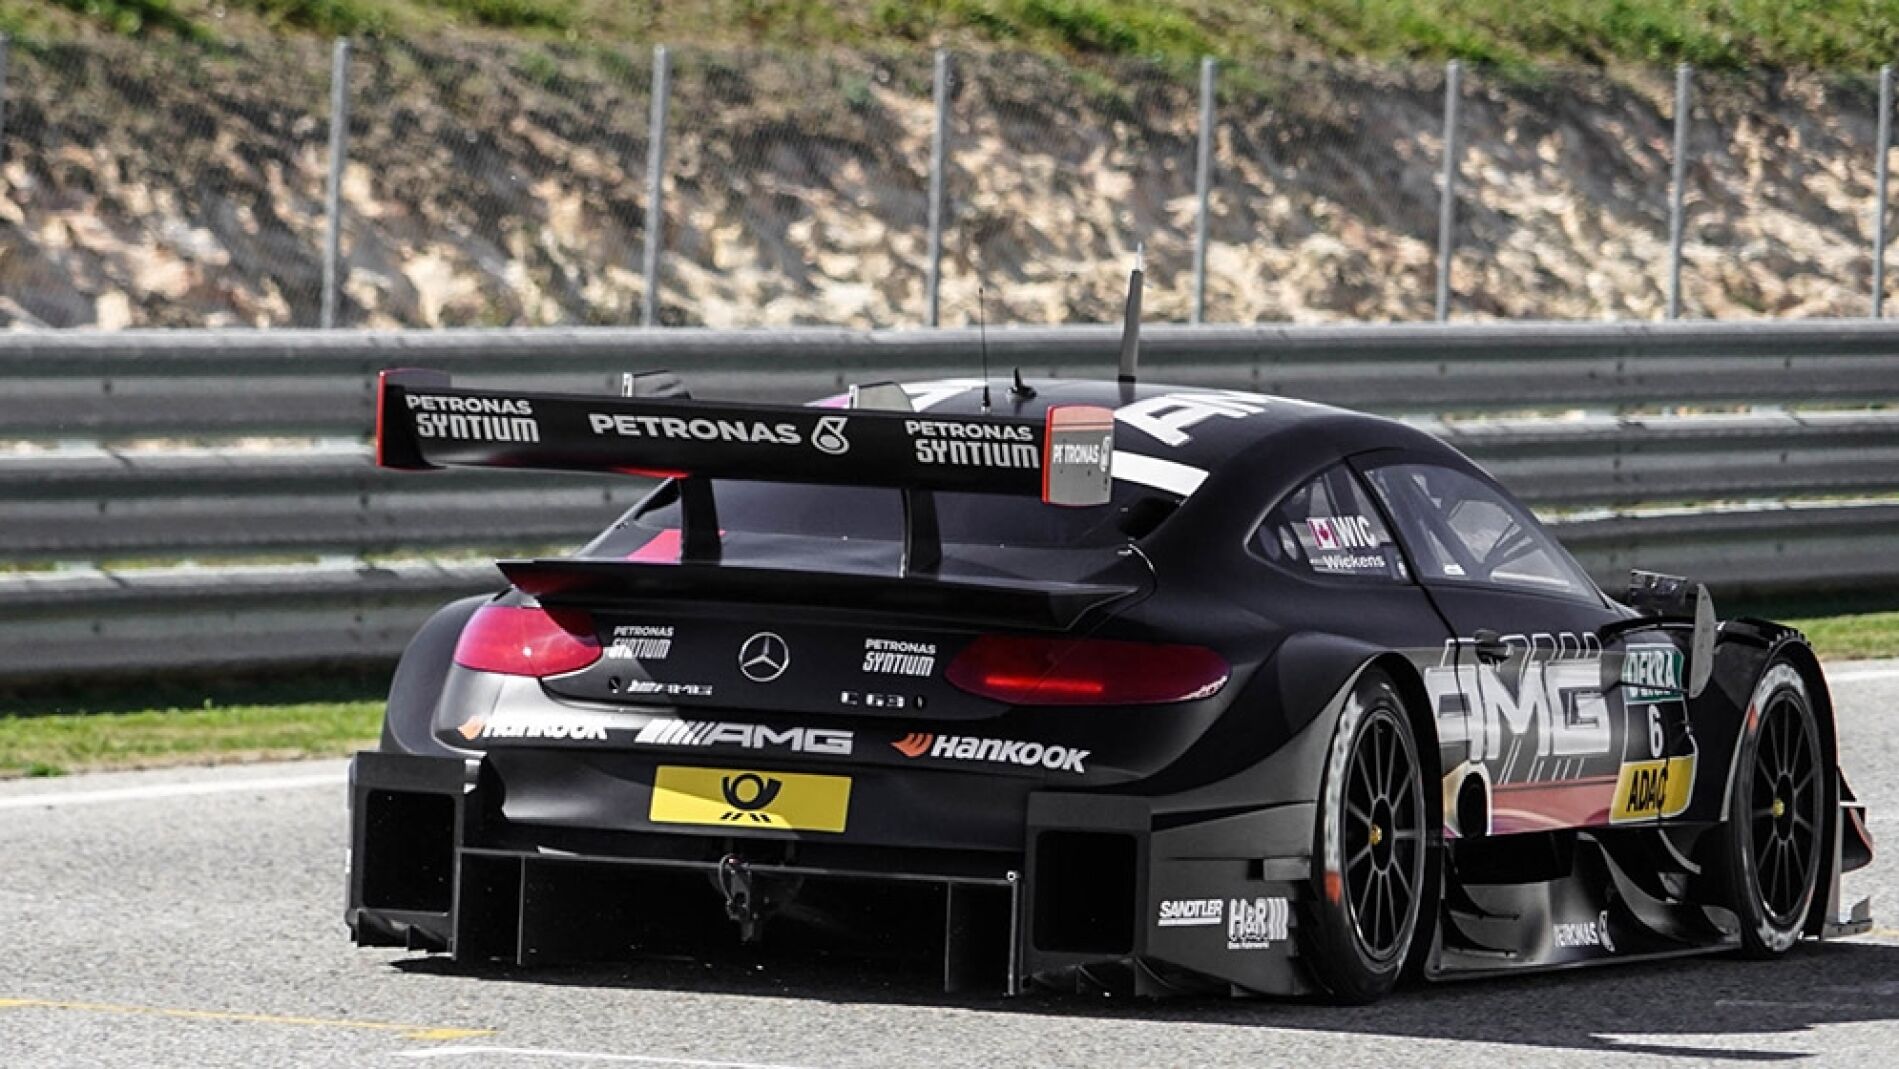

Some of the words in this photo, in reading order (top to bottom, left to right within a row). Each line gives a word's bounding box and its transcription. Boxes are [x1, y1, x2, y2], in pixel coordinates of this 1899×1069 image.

[406, 394, 532, 415] PETRONAS
[416, 414, 539, 442] SYNTIUM
[588, 413, 801, 445] PETRONAS
[905, 420, 1033, 440] PETRONAS
[915, 439, 1039, 469] SYNTIUM
[1053, 444, 1100, 464] PETRONAS
[1331, 515, 1377, 547] WIC
[613, 625, 674, 637] PETRONAS
[865, 638, 936, 654] PETRONAS
[862, 651, 935, 677] SYNTIUM
[1424, 662, 1610, 760] AMG
[704, 722, 853, 754] AMG
[1648, 703, 1664, 759] 6
[1626, 768, 1669, 812] ADAC
[1159, 898, 1224, 919] SANDTLER
